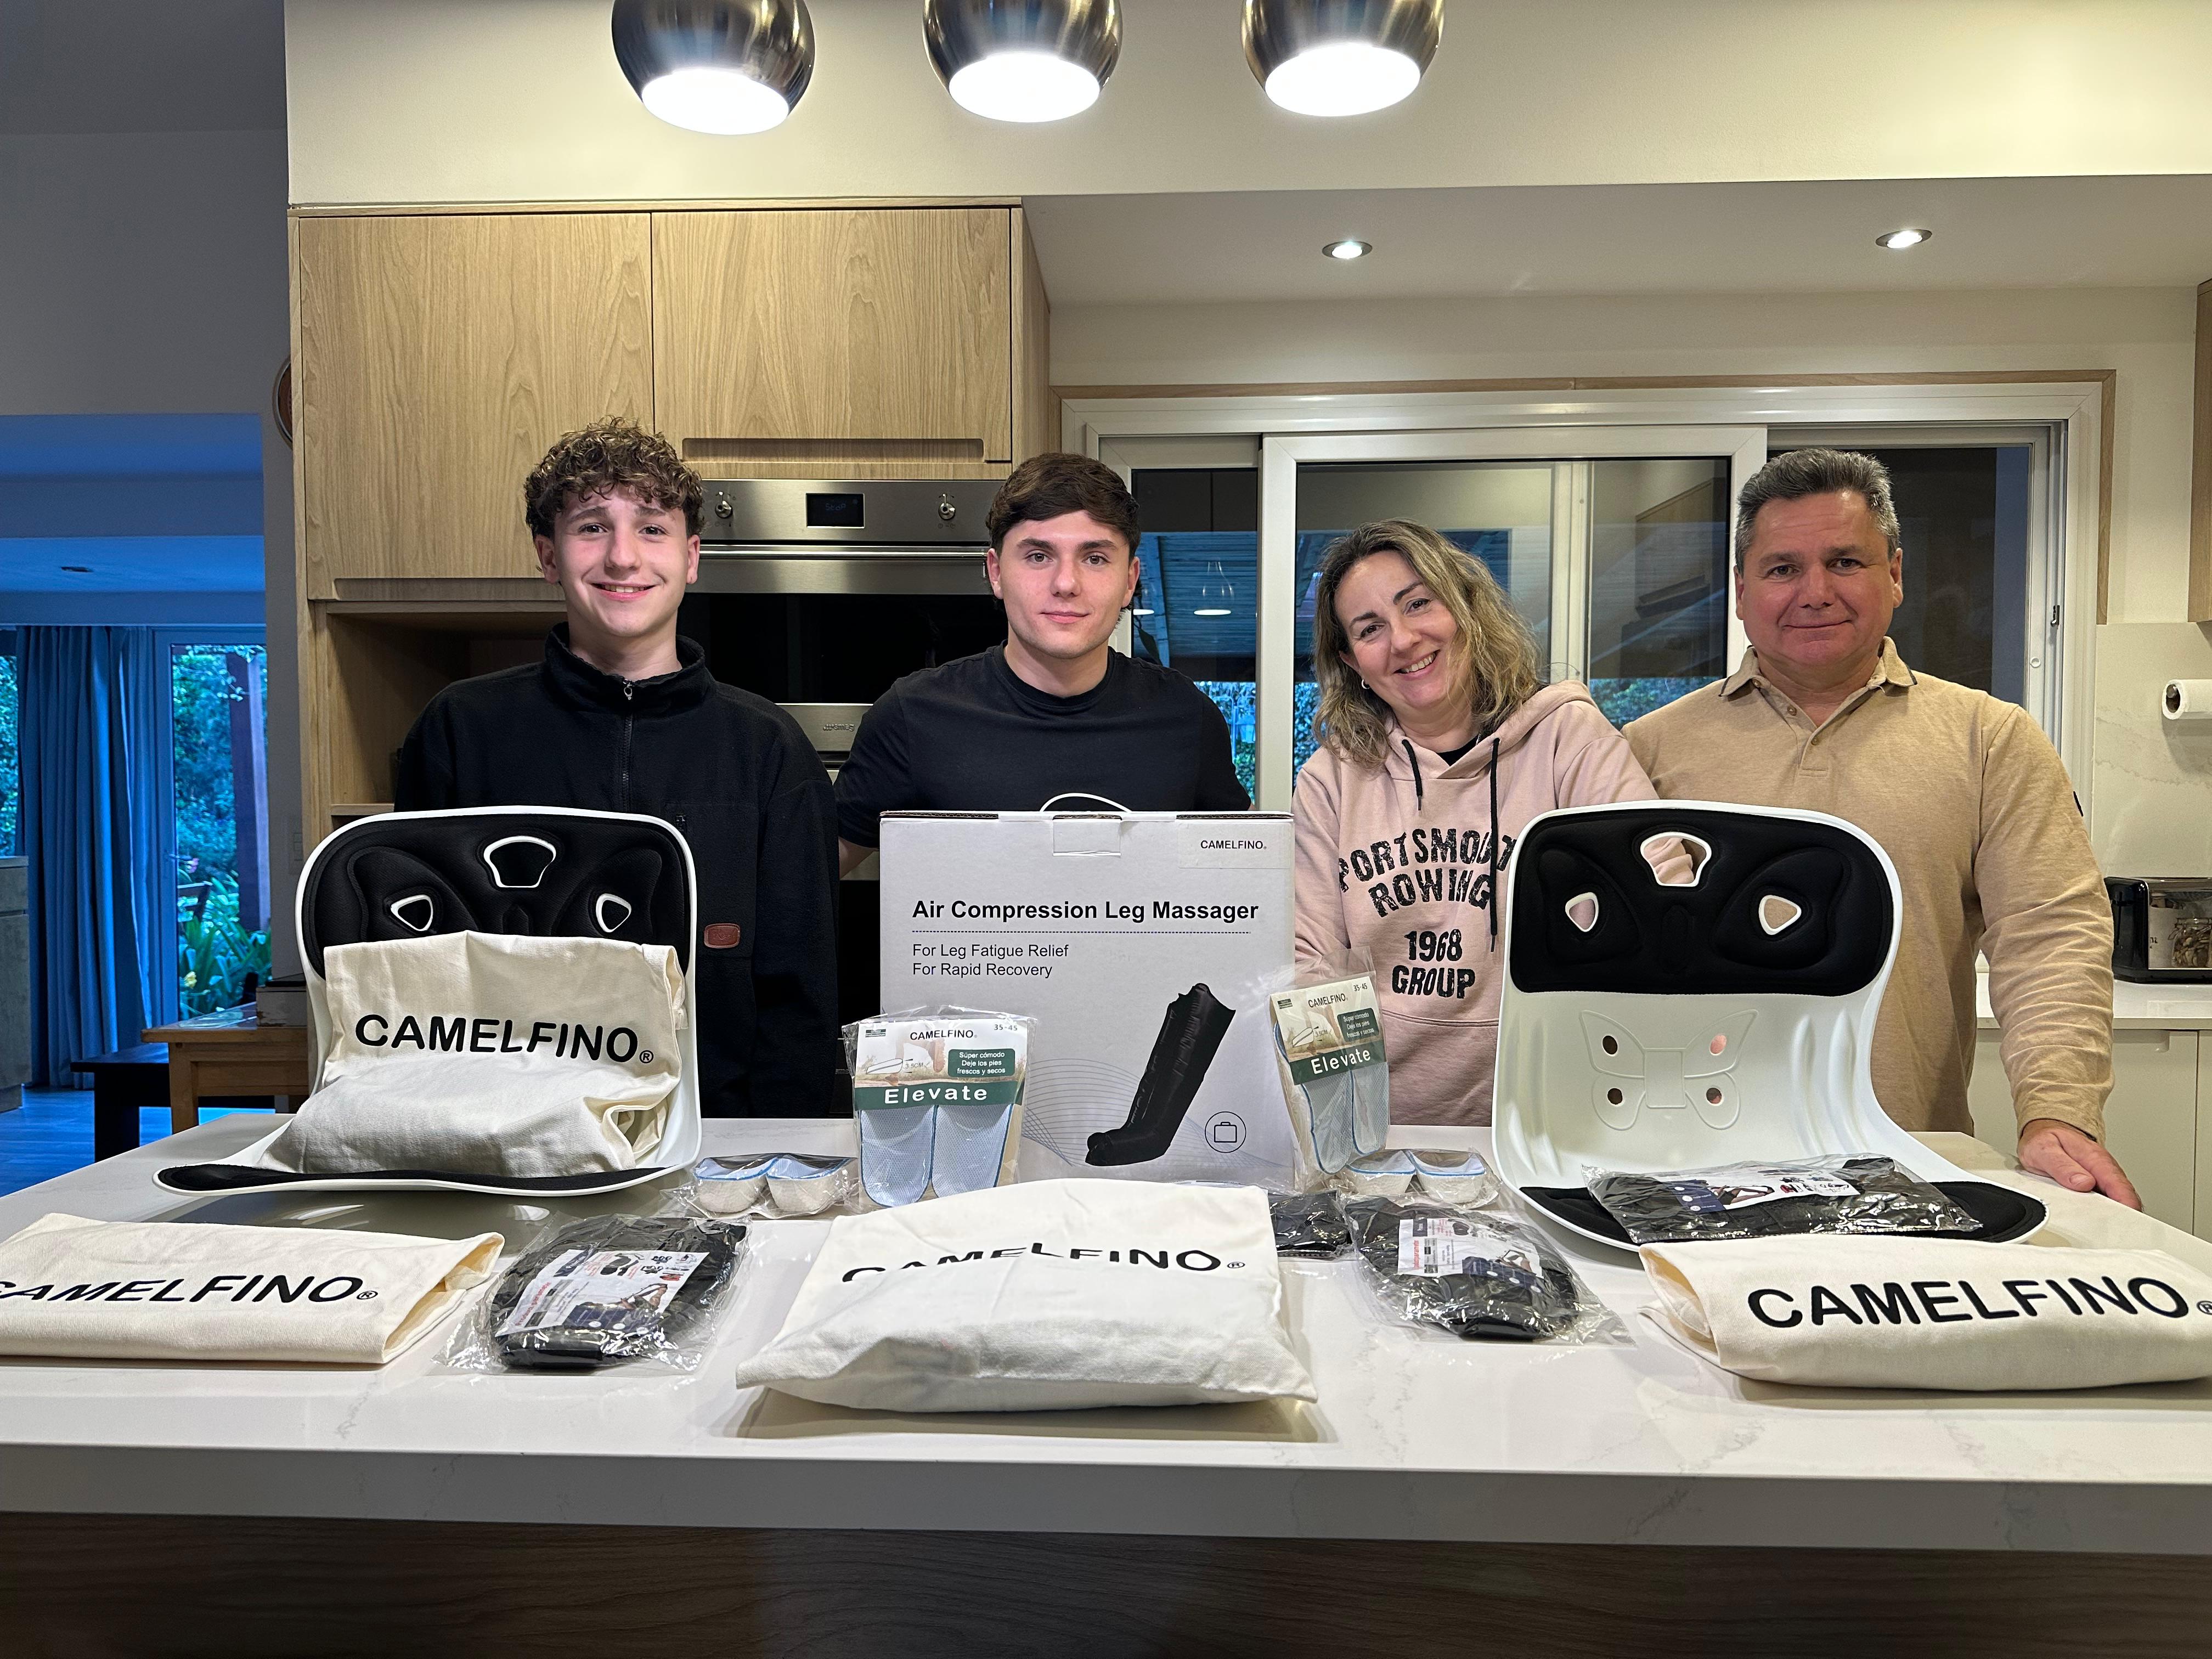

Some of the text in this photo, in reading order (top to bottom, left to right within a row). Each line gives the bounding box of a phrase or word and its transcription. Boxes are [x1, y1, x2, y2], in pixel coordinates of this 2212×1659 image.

[1339, 828, 1517, 893] PORTSMOUT
[1368, 868, 1491, 917] ROWING
[912, 900, 1259, 923] Air Compression Leg Massager
[913, 944, 1069, 960] For Leg Fatigue Relief
[1404, 928, 1463, 962] 1968
[913, 963, 1053, 979] For Rapid Recovery
[1392, 964, 1476, 999] GROUP
[1353, 983, 1368, 991] 35-45
[1311, 1048, 1371, 1074] Elevate
[884, 1085, 987, 1104] Elevate
